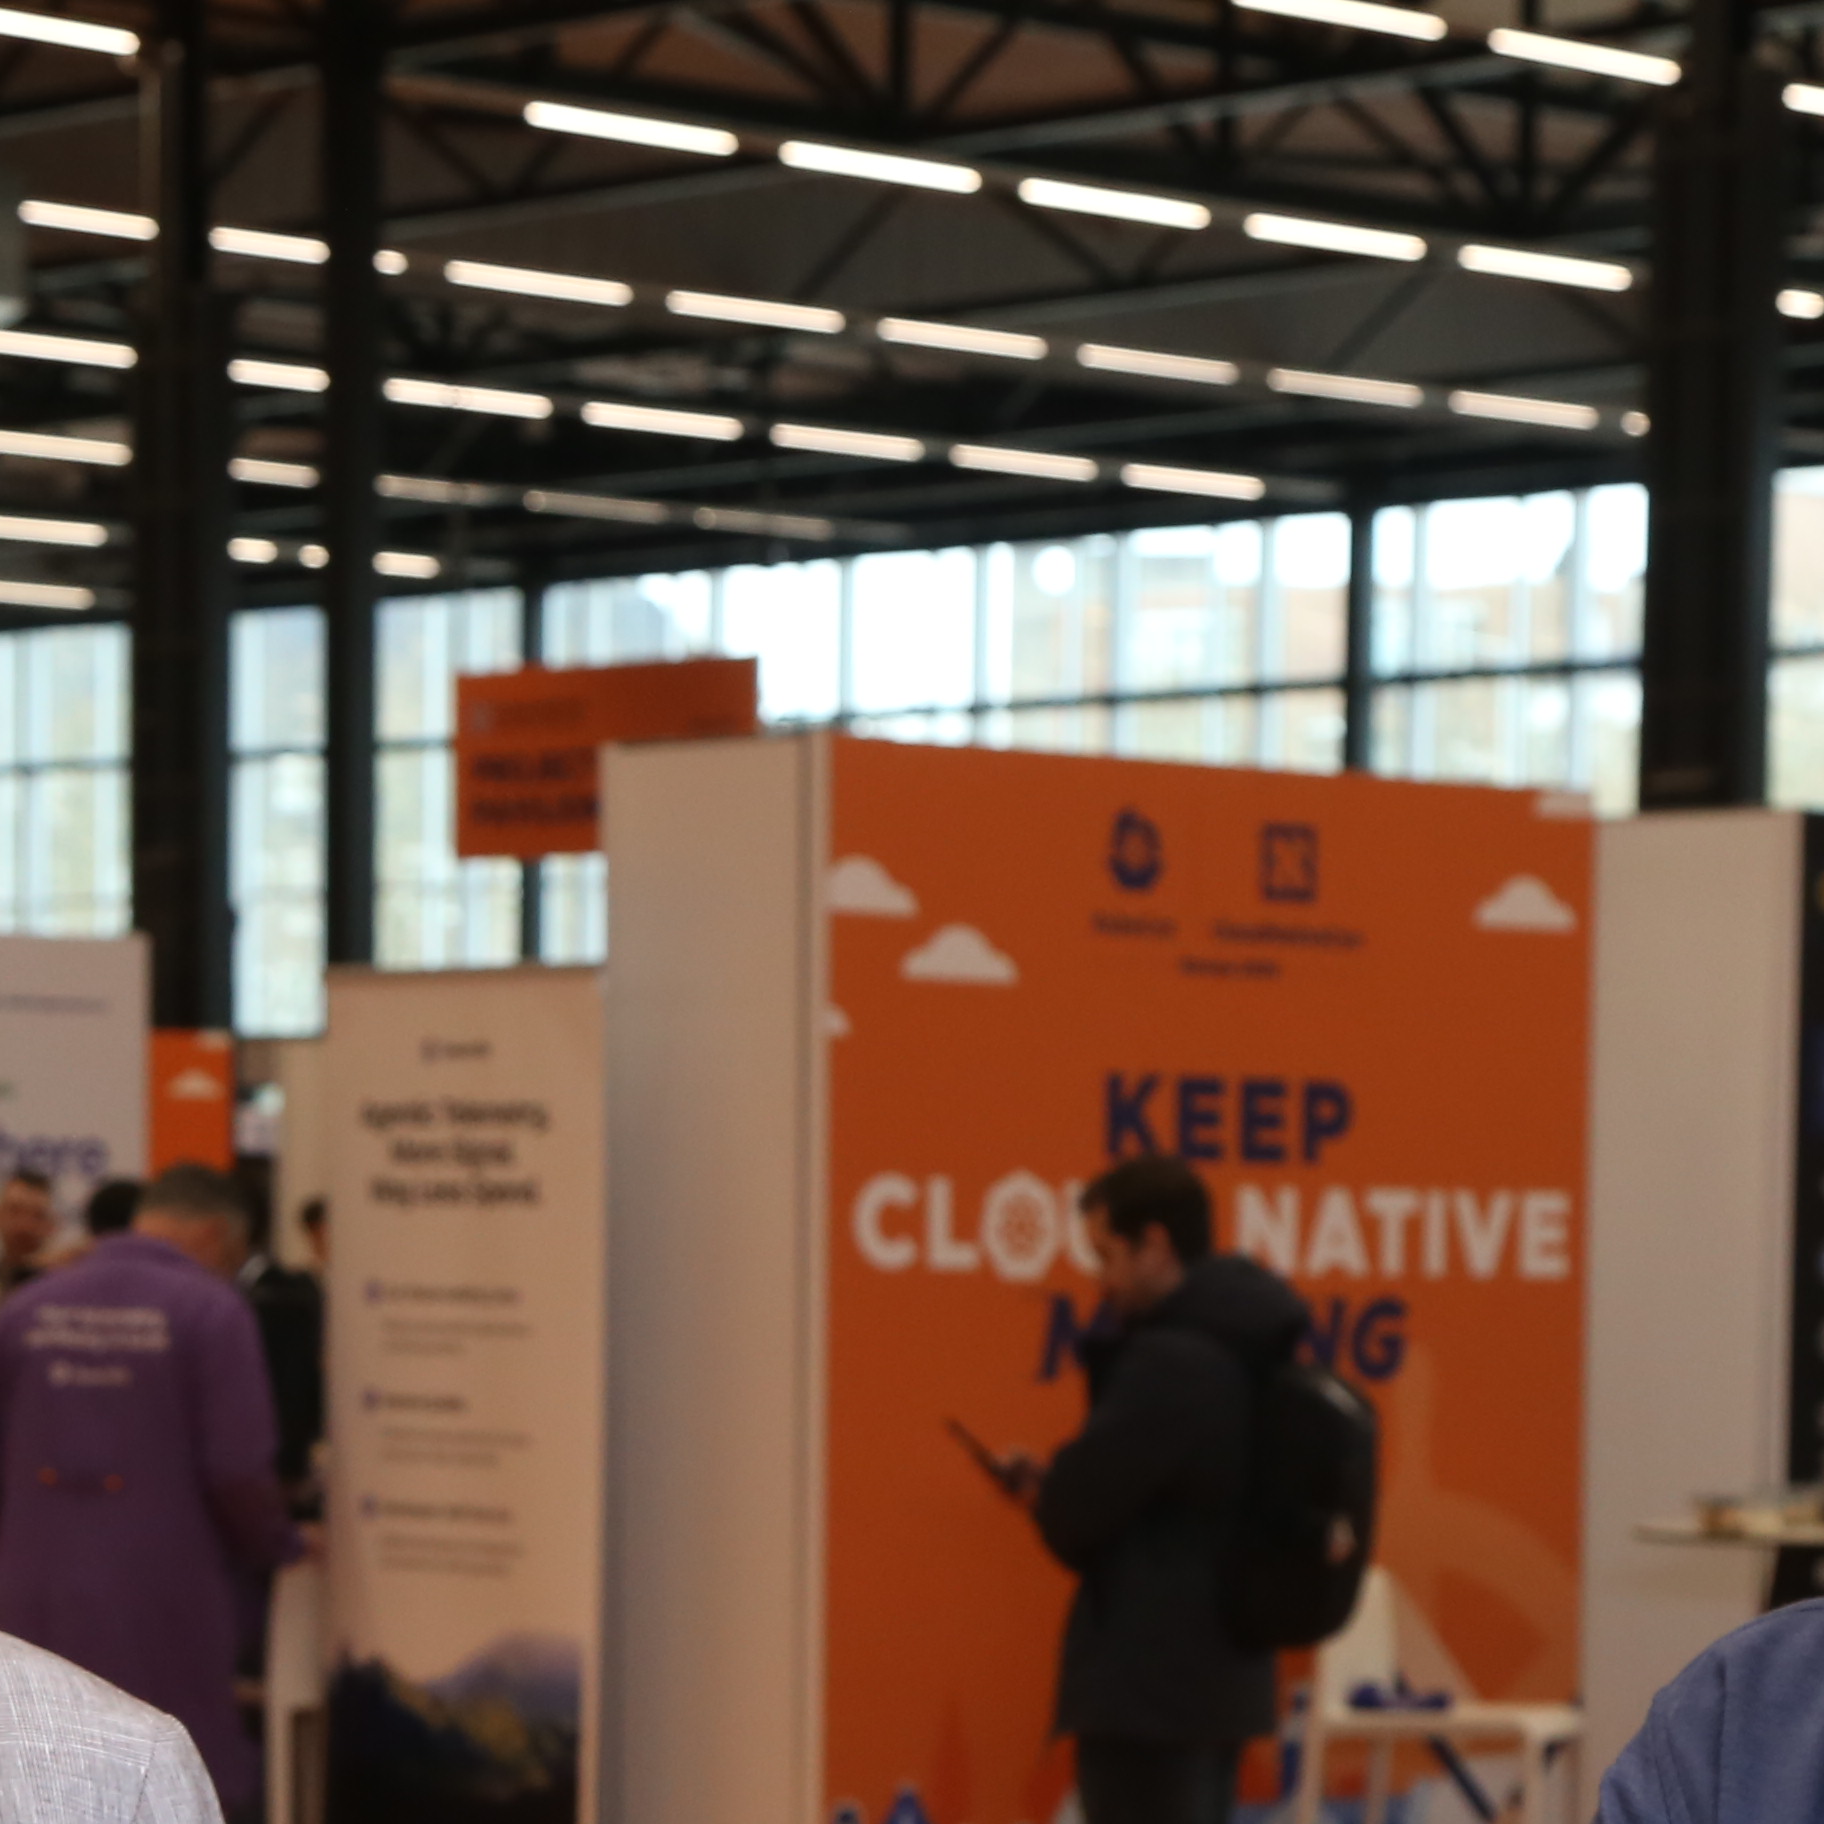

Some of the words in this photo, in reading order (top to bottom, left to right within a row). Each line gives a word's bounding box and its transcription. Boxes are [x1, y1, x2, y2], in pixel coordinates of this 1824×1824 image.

[1106, 1073, 1354, 1164] KEEP
[852, 1169, 1104, 1282] CLOU
[1235, 1185, 1572, 1280] NATIVE
[1036, 1294, 1408, 1382] MNG
